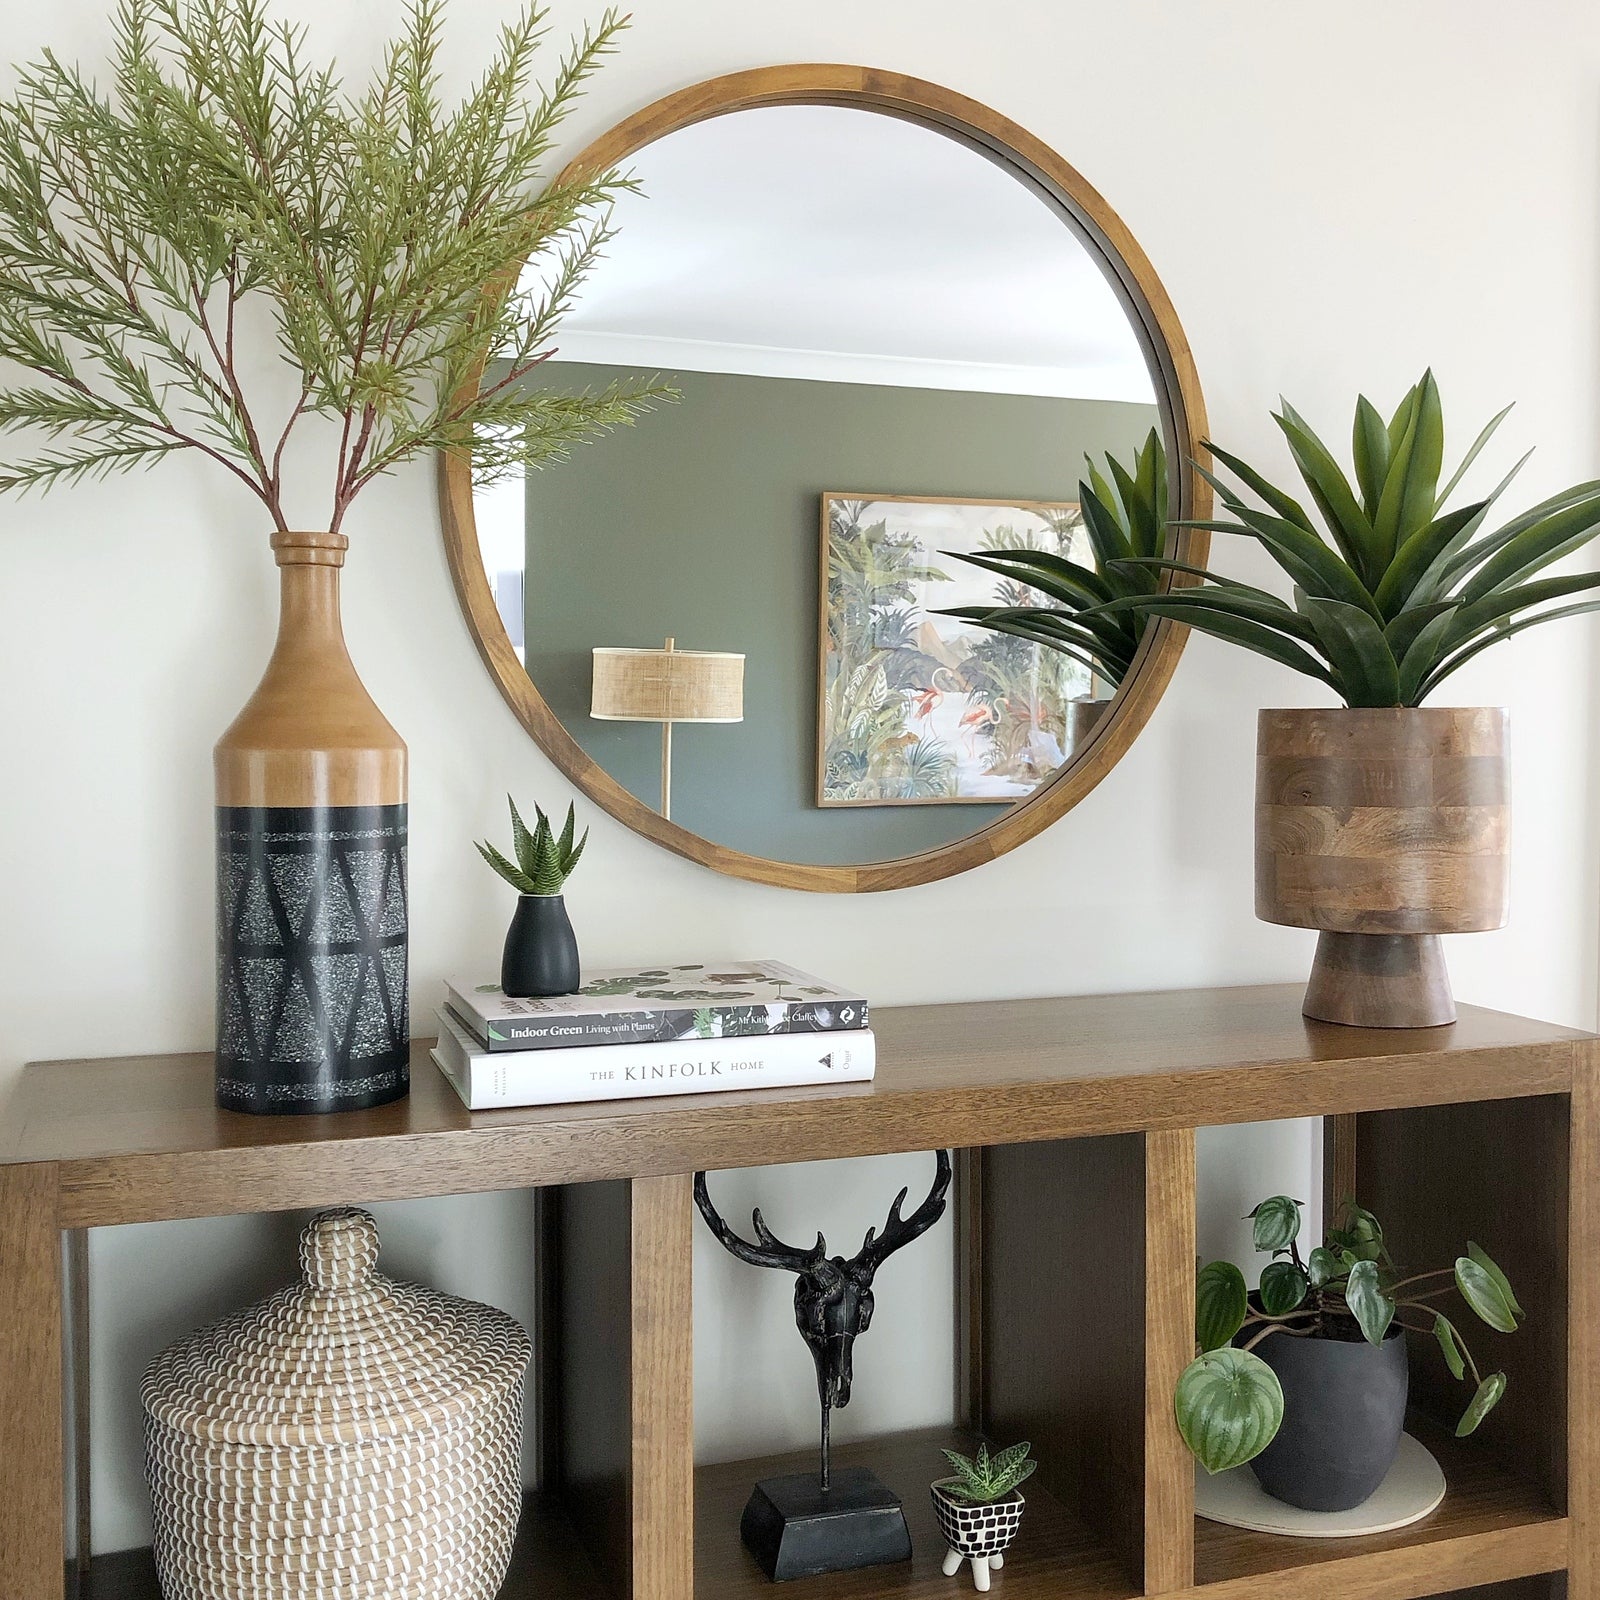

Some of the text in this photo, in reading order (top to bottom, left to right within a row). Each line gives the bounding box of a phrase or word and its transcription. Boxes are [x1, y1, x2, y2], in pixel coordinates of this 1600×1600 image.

[738, 1016, 749, 1025] Mr
[510, 1022, 655, 1039] Indoor Green Living with Plants
[590, 1060, 765, 1081] THE KINFOLK HOME
